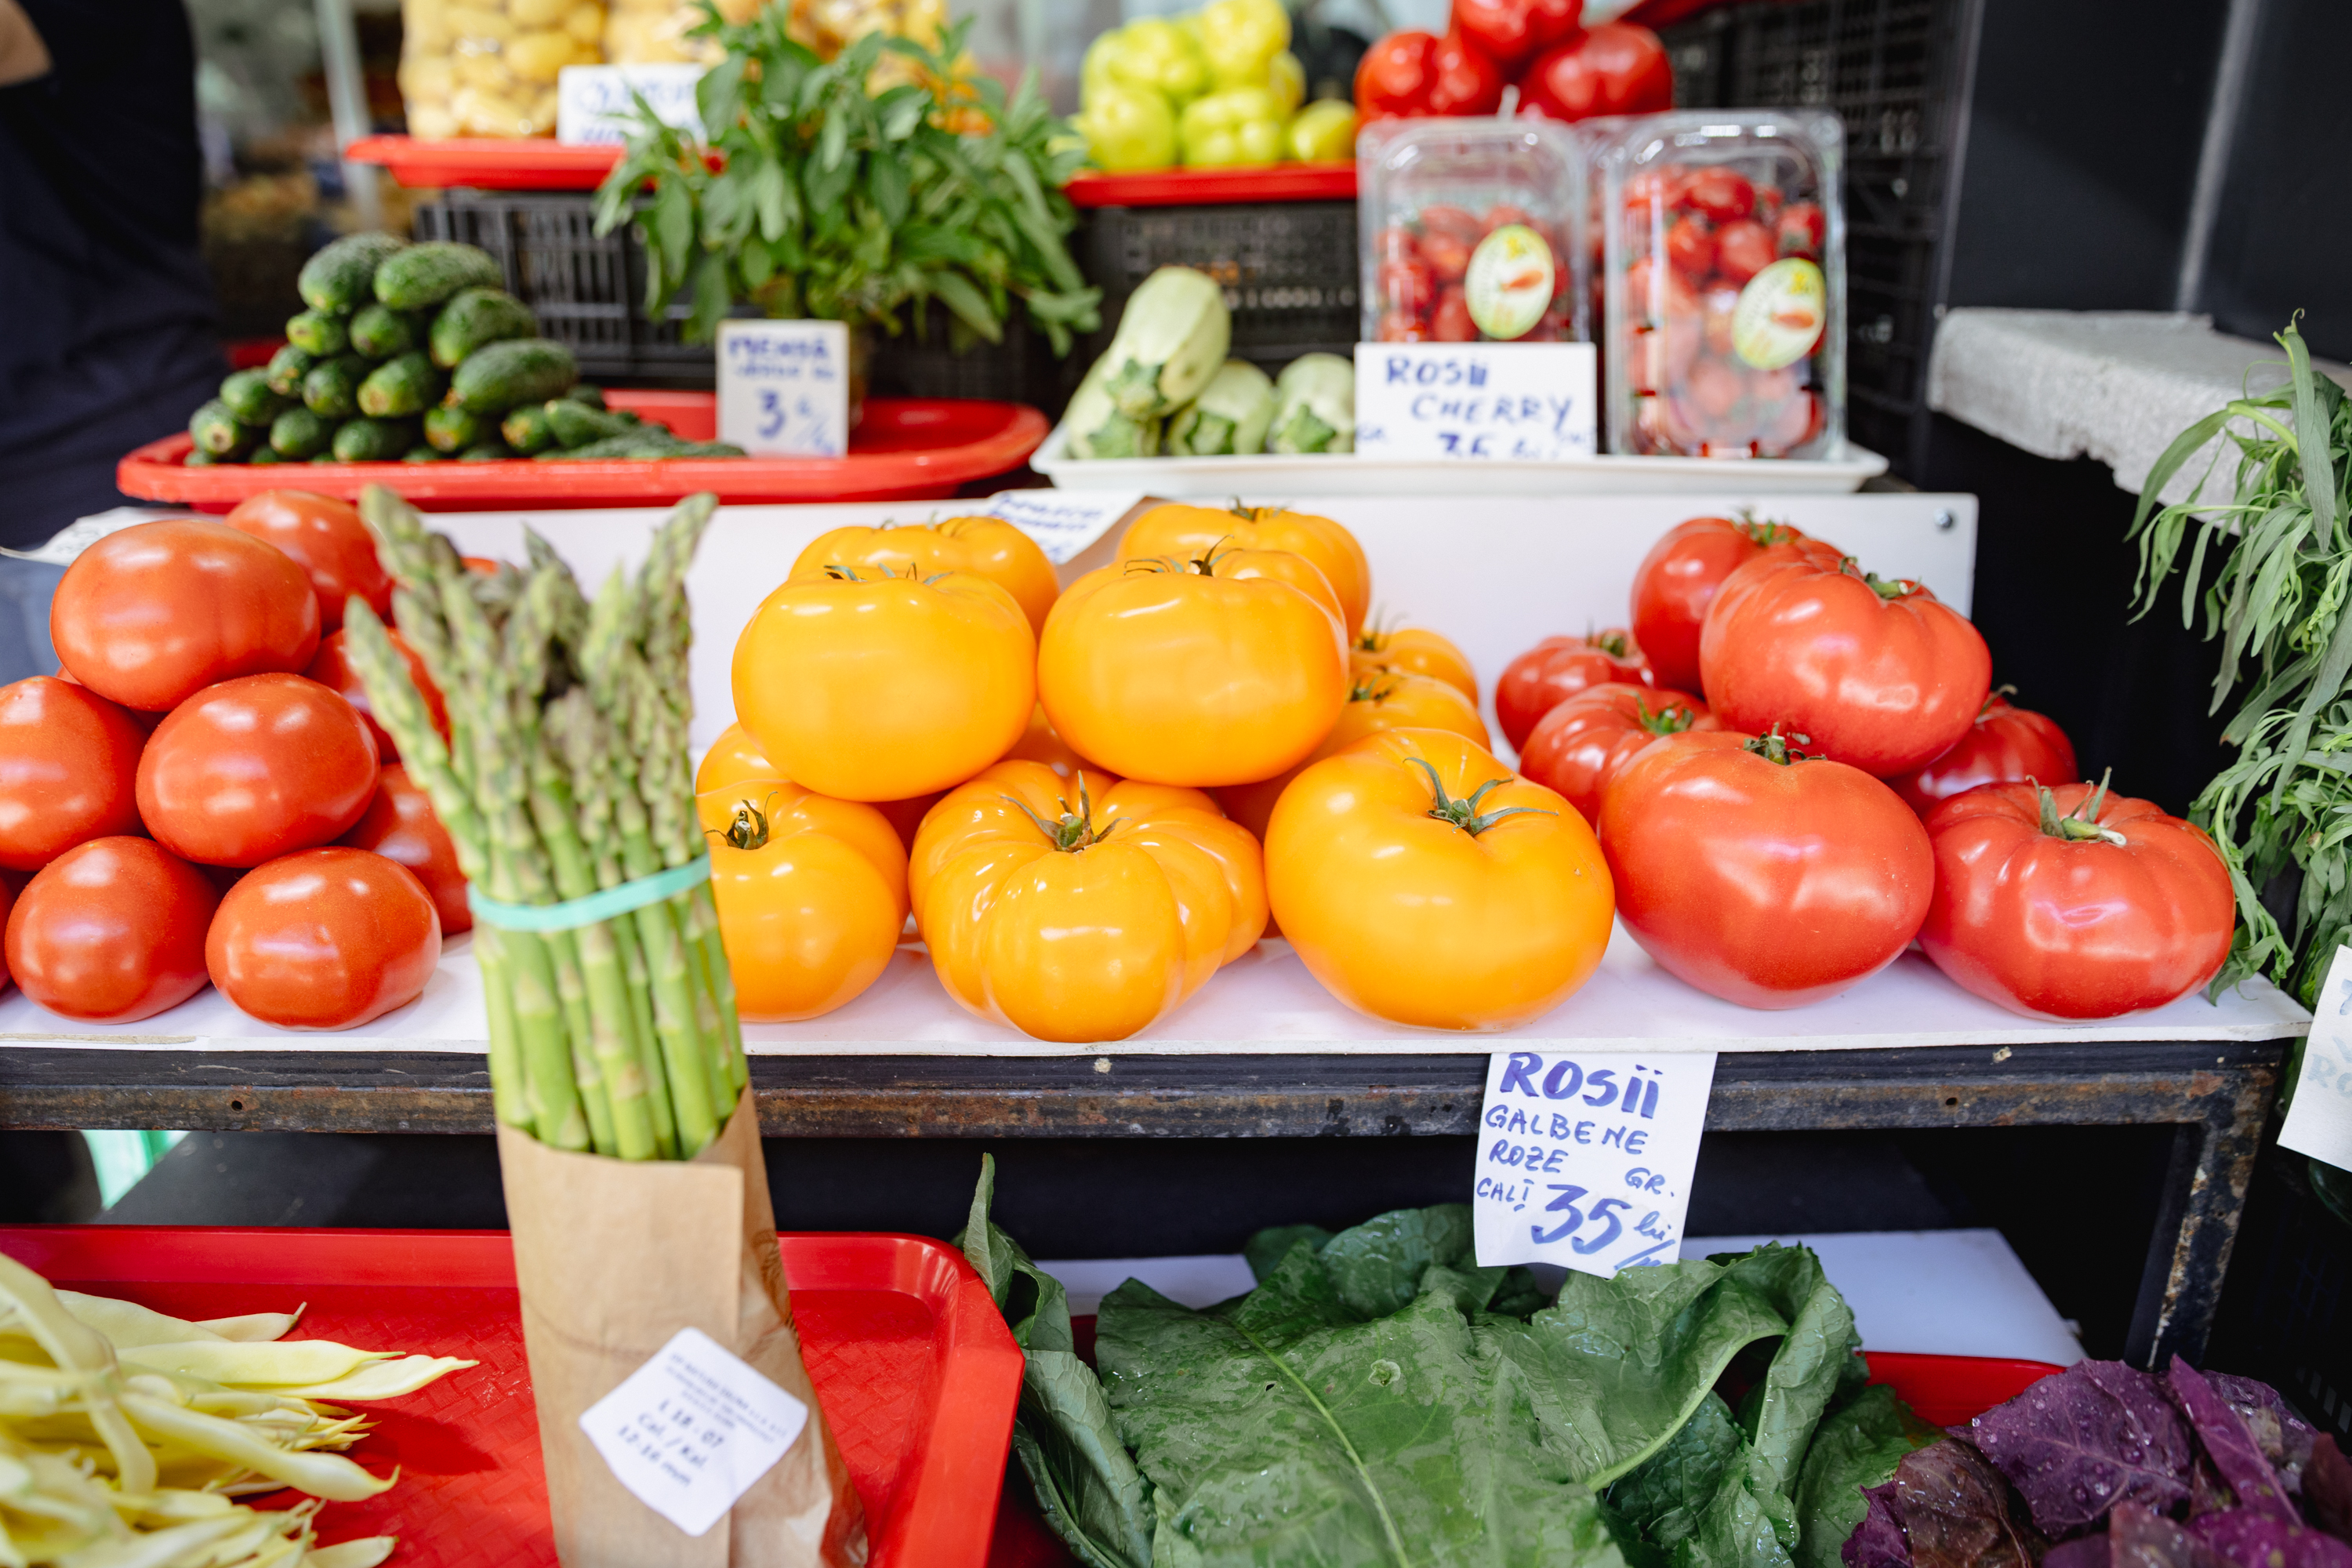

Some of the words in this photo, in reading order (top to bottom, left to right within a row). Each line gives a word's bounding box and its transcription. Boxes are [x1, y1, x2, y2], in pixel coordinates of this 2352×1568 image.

[1411, 393, 1572, 431] CHERRY
[1485, 1104, 1648, 1154] GALBENE
[1489, 1139, 1568, 1174] ROZE
[1624, 1167, 1675, 1197] GR.
[1530, 1184, 1632, 1255] 35
[701, 1429, 724, 1448] 07
